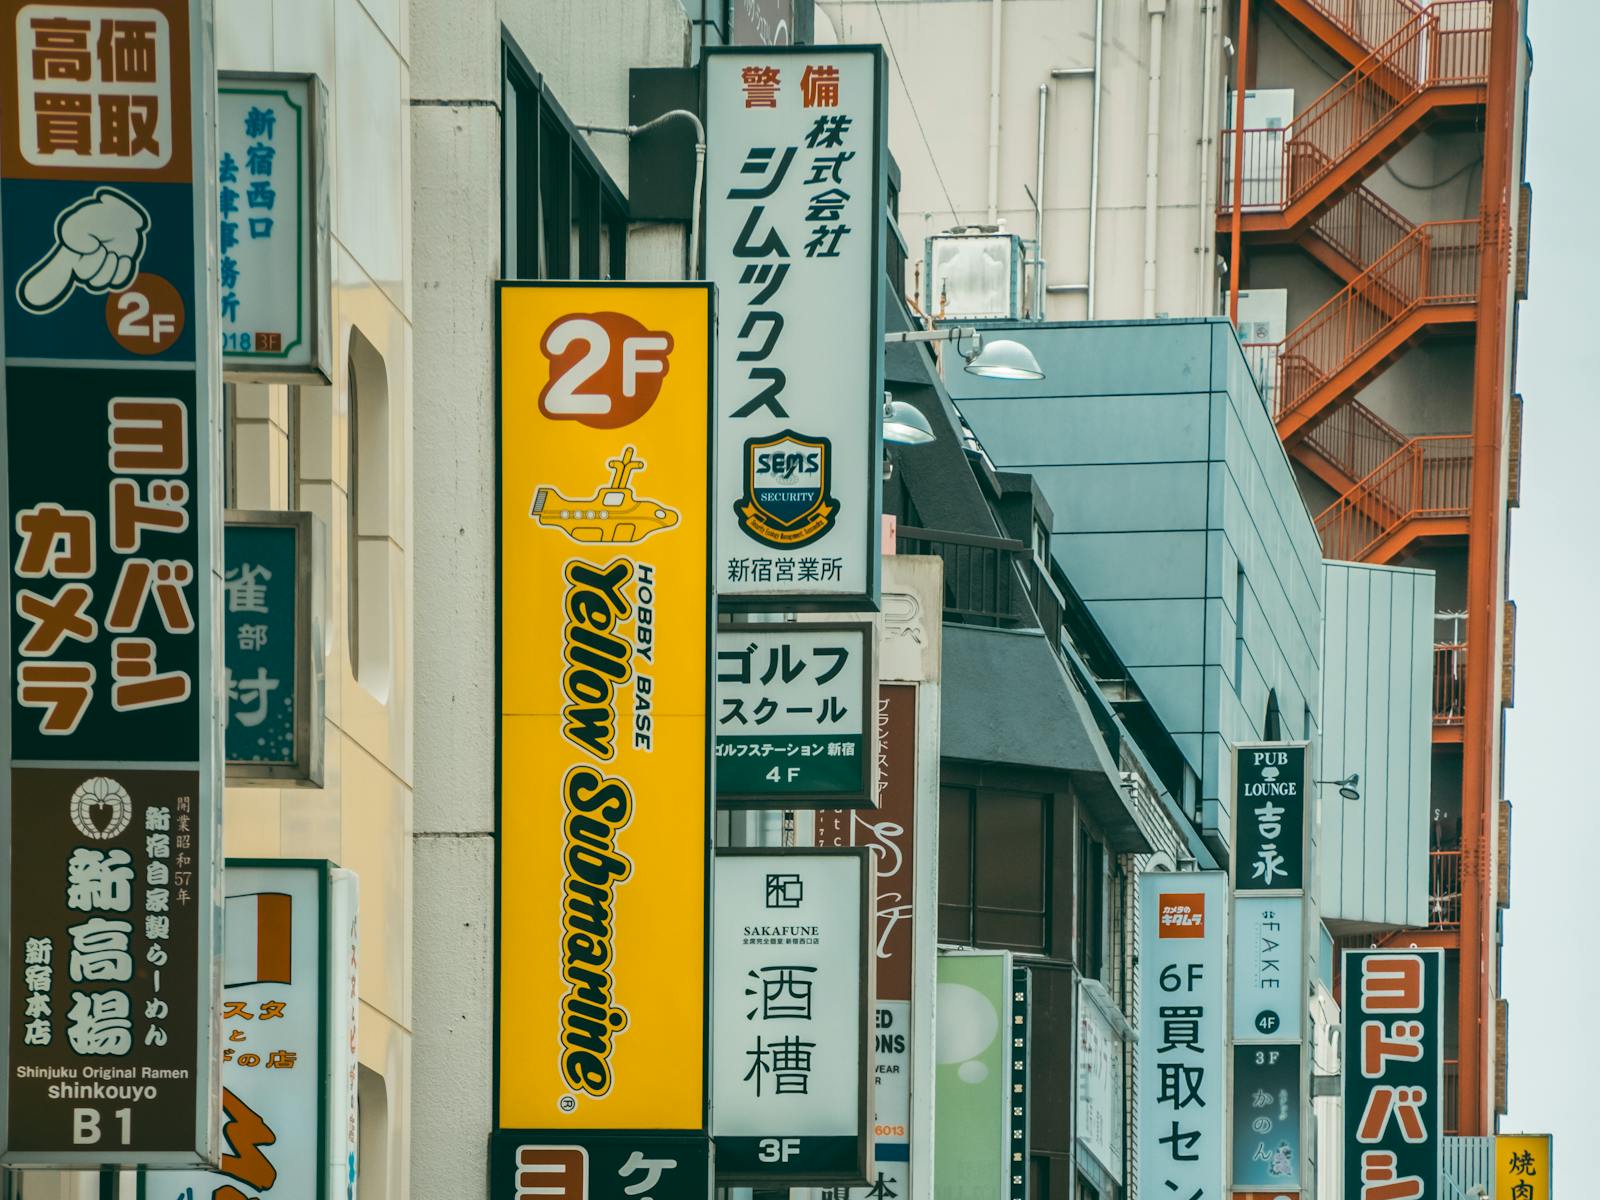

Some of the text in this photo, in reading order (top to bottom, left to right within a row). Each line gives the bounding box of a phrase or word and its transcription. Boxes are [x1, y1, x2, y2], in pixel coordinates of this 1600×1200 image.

[30, 17, 157, 84] 高価
[741, 65, 840, 108] 警備
[34, 92, 160, 157] 買取
[244, 106, 276, 239] 新宿西口
[803, 115, 856, 258] 株式会社
[726, 146, 798, 418] シムックス
[116, 292, 176, 343] 2F
[544, 318, 669, 415] 2F
[760, 493, 815, 502] SECURITY
[104, 397, 195, 713] ヨドバシ
[727, 557, 843, 583] 新宿営業所
[14, 502, 99, 736] カメラ
[634, 564, 653, 750] HOBBY BASE
[717, 642, 849, 686] ゴルフ
[719, 696, 848, 725] スクール
[827, 742, 855, 756] 新宿
[1254, 751, 1289, 765] PUB
[1244, 782, 1297, 797] LOUNGE
[563, 560, 633, 1093] Yellow Submarine
[1251, 801, 1289, 885] 吉永
[66, 847, 135, 1056] 新高揚
[143, 806, 171, 1047] 新宿自家製らーめん
[743, 926, 819, 936] SAKAFUNE
[1261, 922, 1280, 989] FAKE
[24, 936, 54, 1046] 新宿本店
[1159, 963, 1204, 992] 6F
[743, 965, 818, 1098] 酒槽
[1259, 1016, 1275, 1029] 4F
[16, 1065, 189, 1083] Shinjuku Original Ramen
[47, 1073, 158, 1102] shinkouyo
[758, 1138, 801, 1163] 3F
